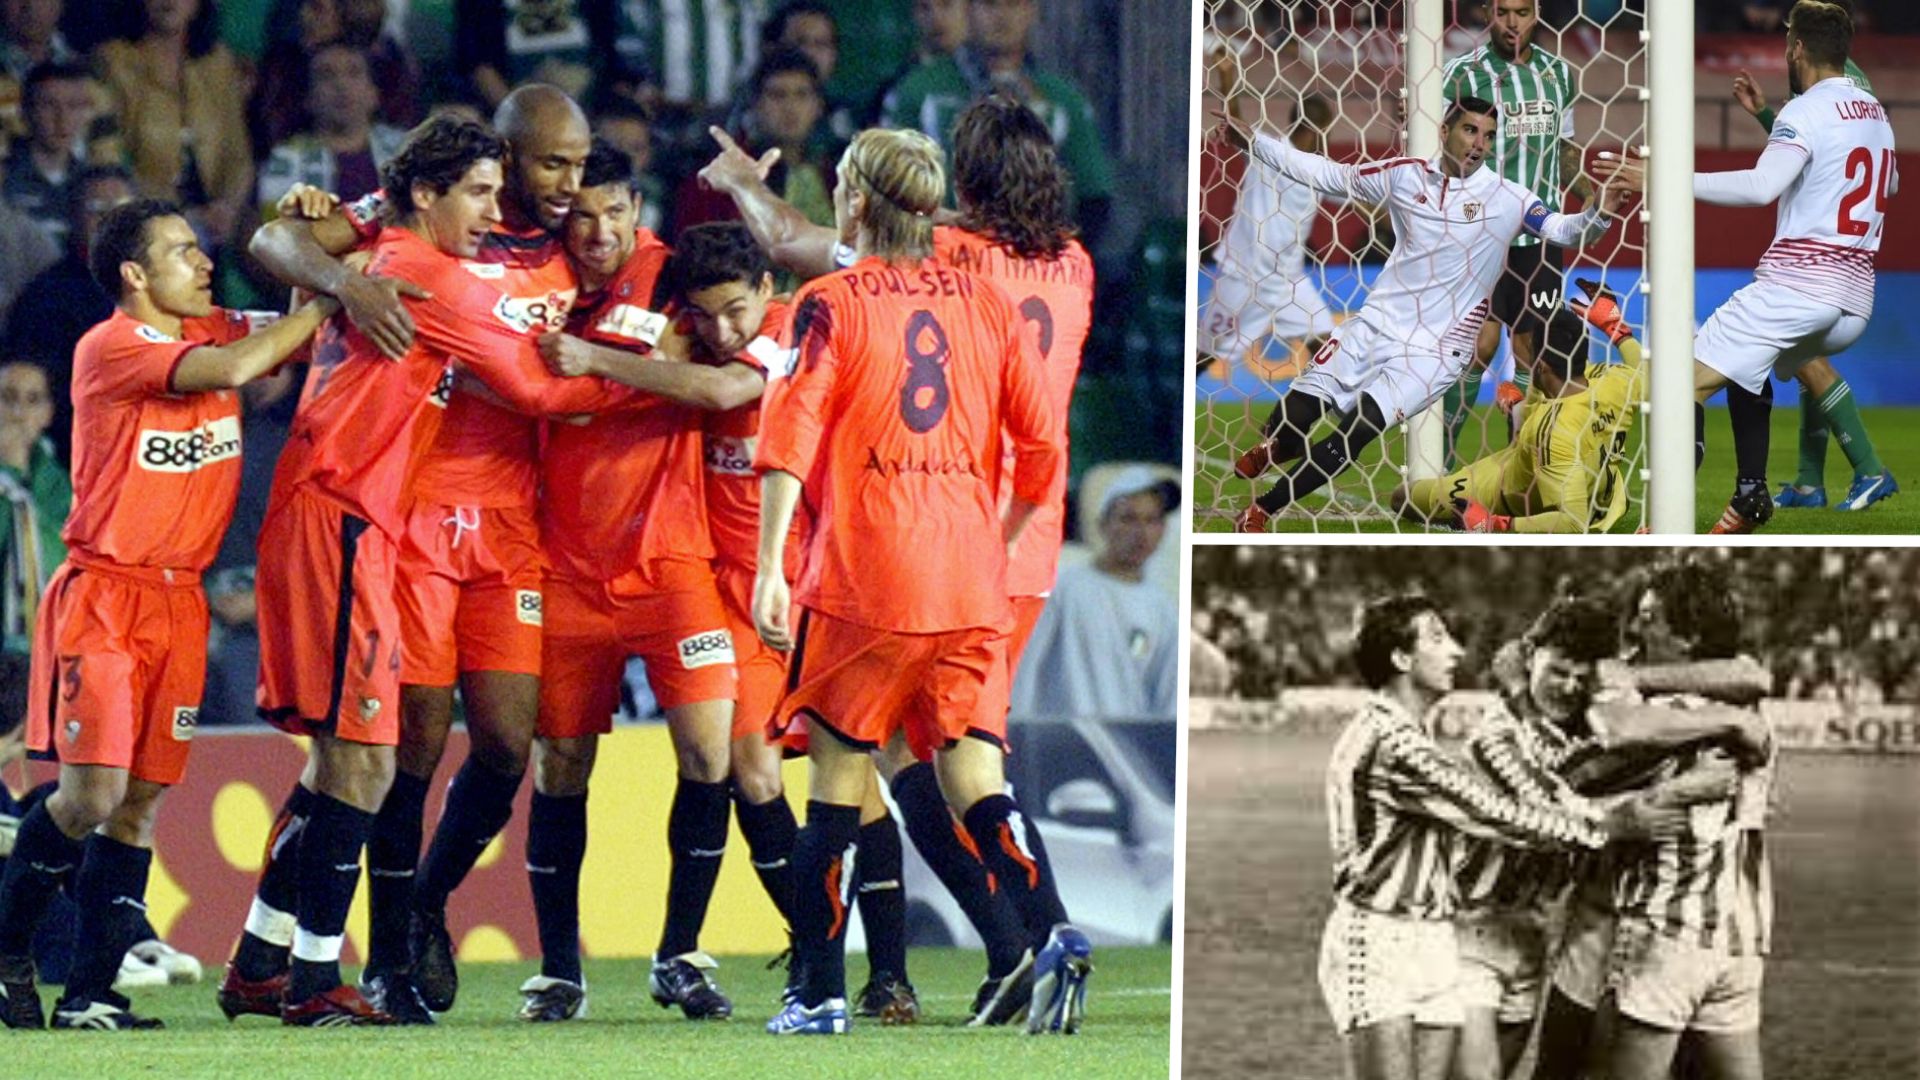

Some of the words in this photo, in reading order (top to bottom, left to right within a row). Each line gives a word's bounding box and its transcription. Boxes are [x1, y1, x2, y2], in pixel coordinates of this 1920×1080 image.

[1503, 101, 1556, 117] UED
[1835, 100, 1890, 122] LLORENT
[1837, 147, 1897, 238] 24
[843, 268, 974, 299] POULSEN
[901, 309, 950, 433] 8
